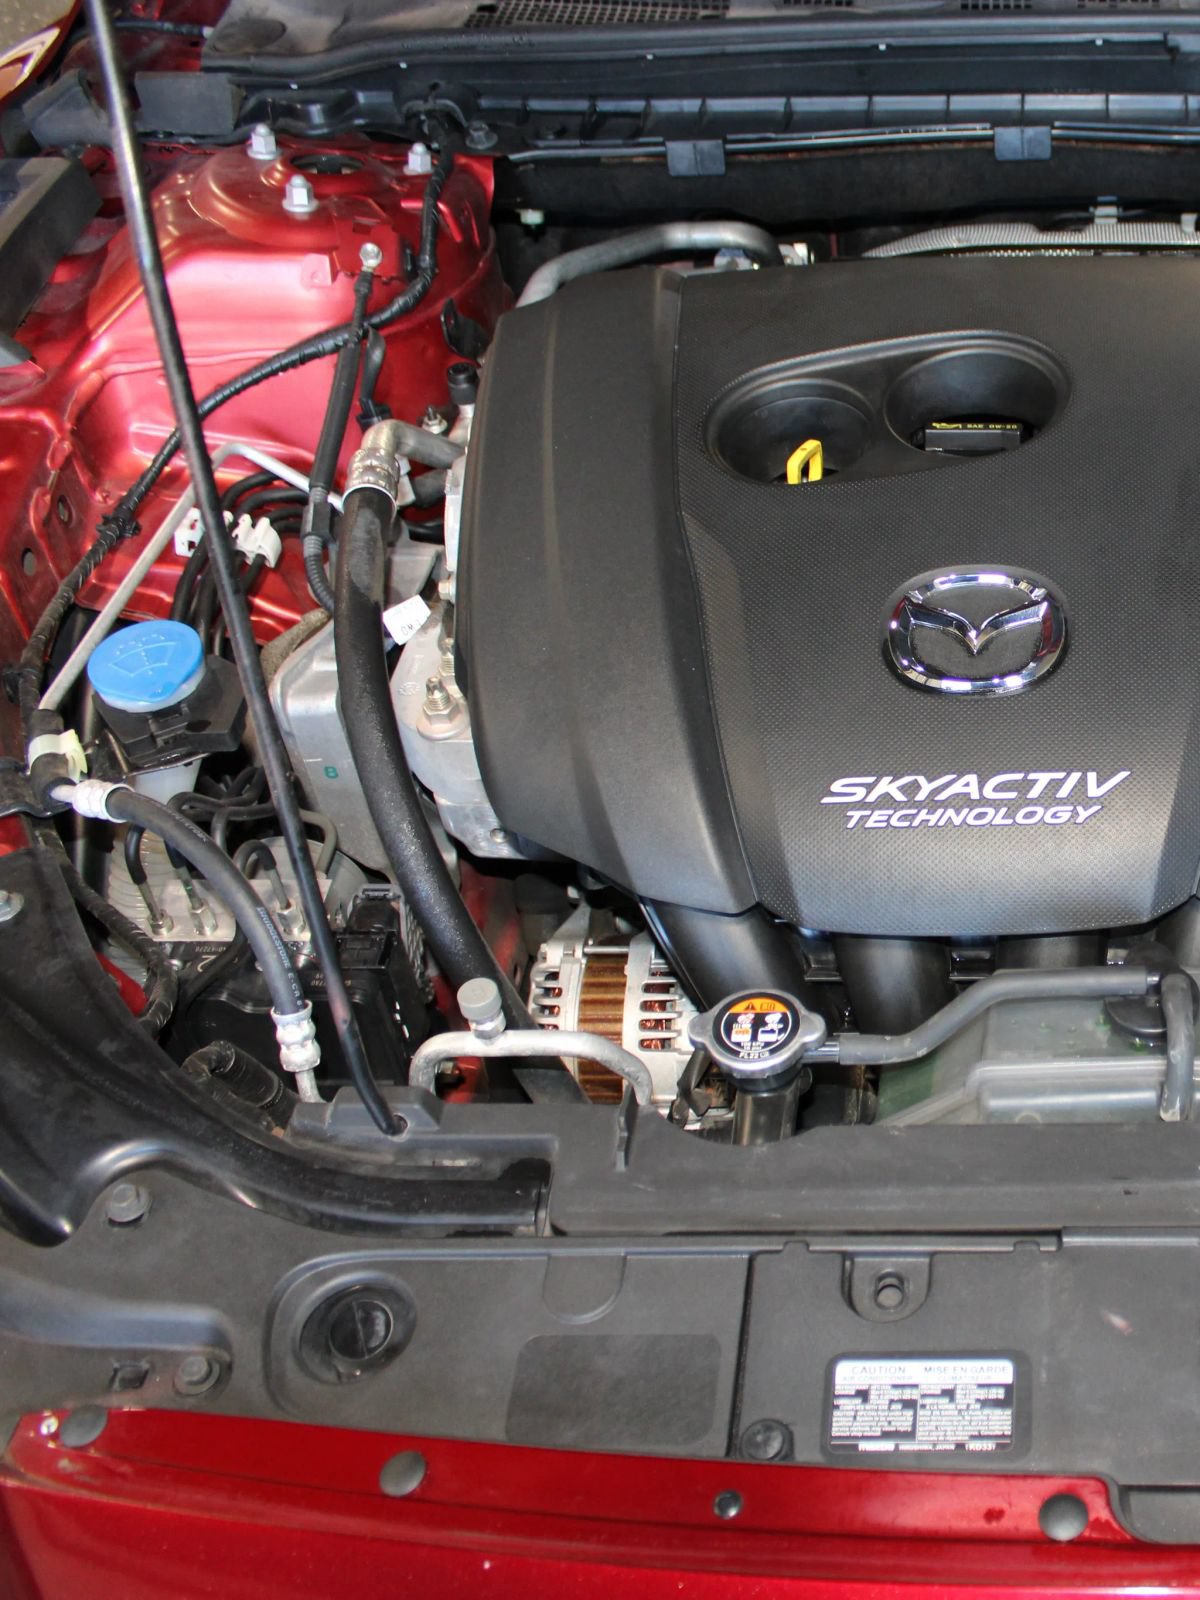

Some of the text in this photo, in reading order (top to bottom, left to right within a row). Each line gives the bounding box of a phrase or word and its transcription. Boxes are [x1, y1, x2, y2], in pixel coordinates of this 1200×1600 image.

[324, 766, 338, 779] B
[820, 770, 1131, 804] SKYACTIV
[846, 805, 1102, 829] TECHNOLOGY
[256, 906, 291, 969] BRIDGESTONE
[852, 1366, 906, 1375] CAUTION
[924, 1366, 1008, 1375] MISE EN GARDE
